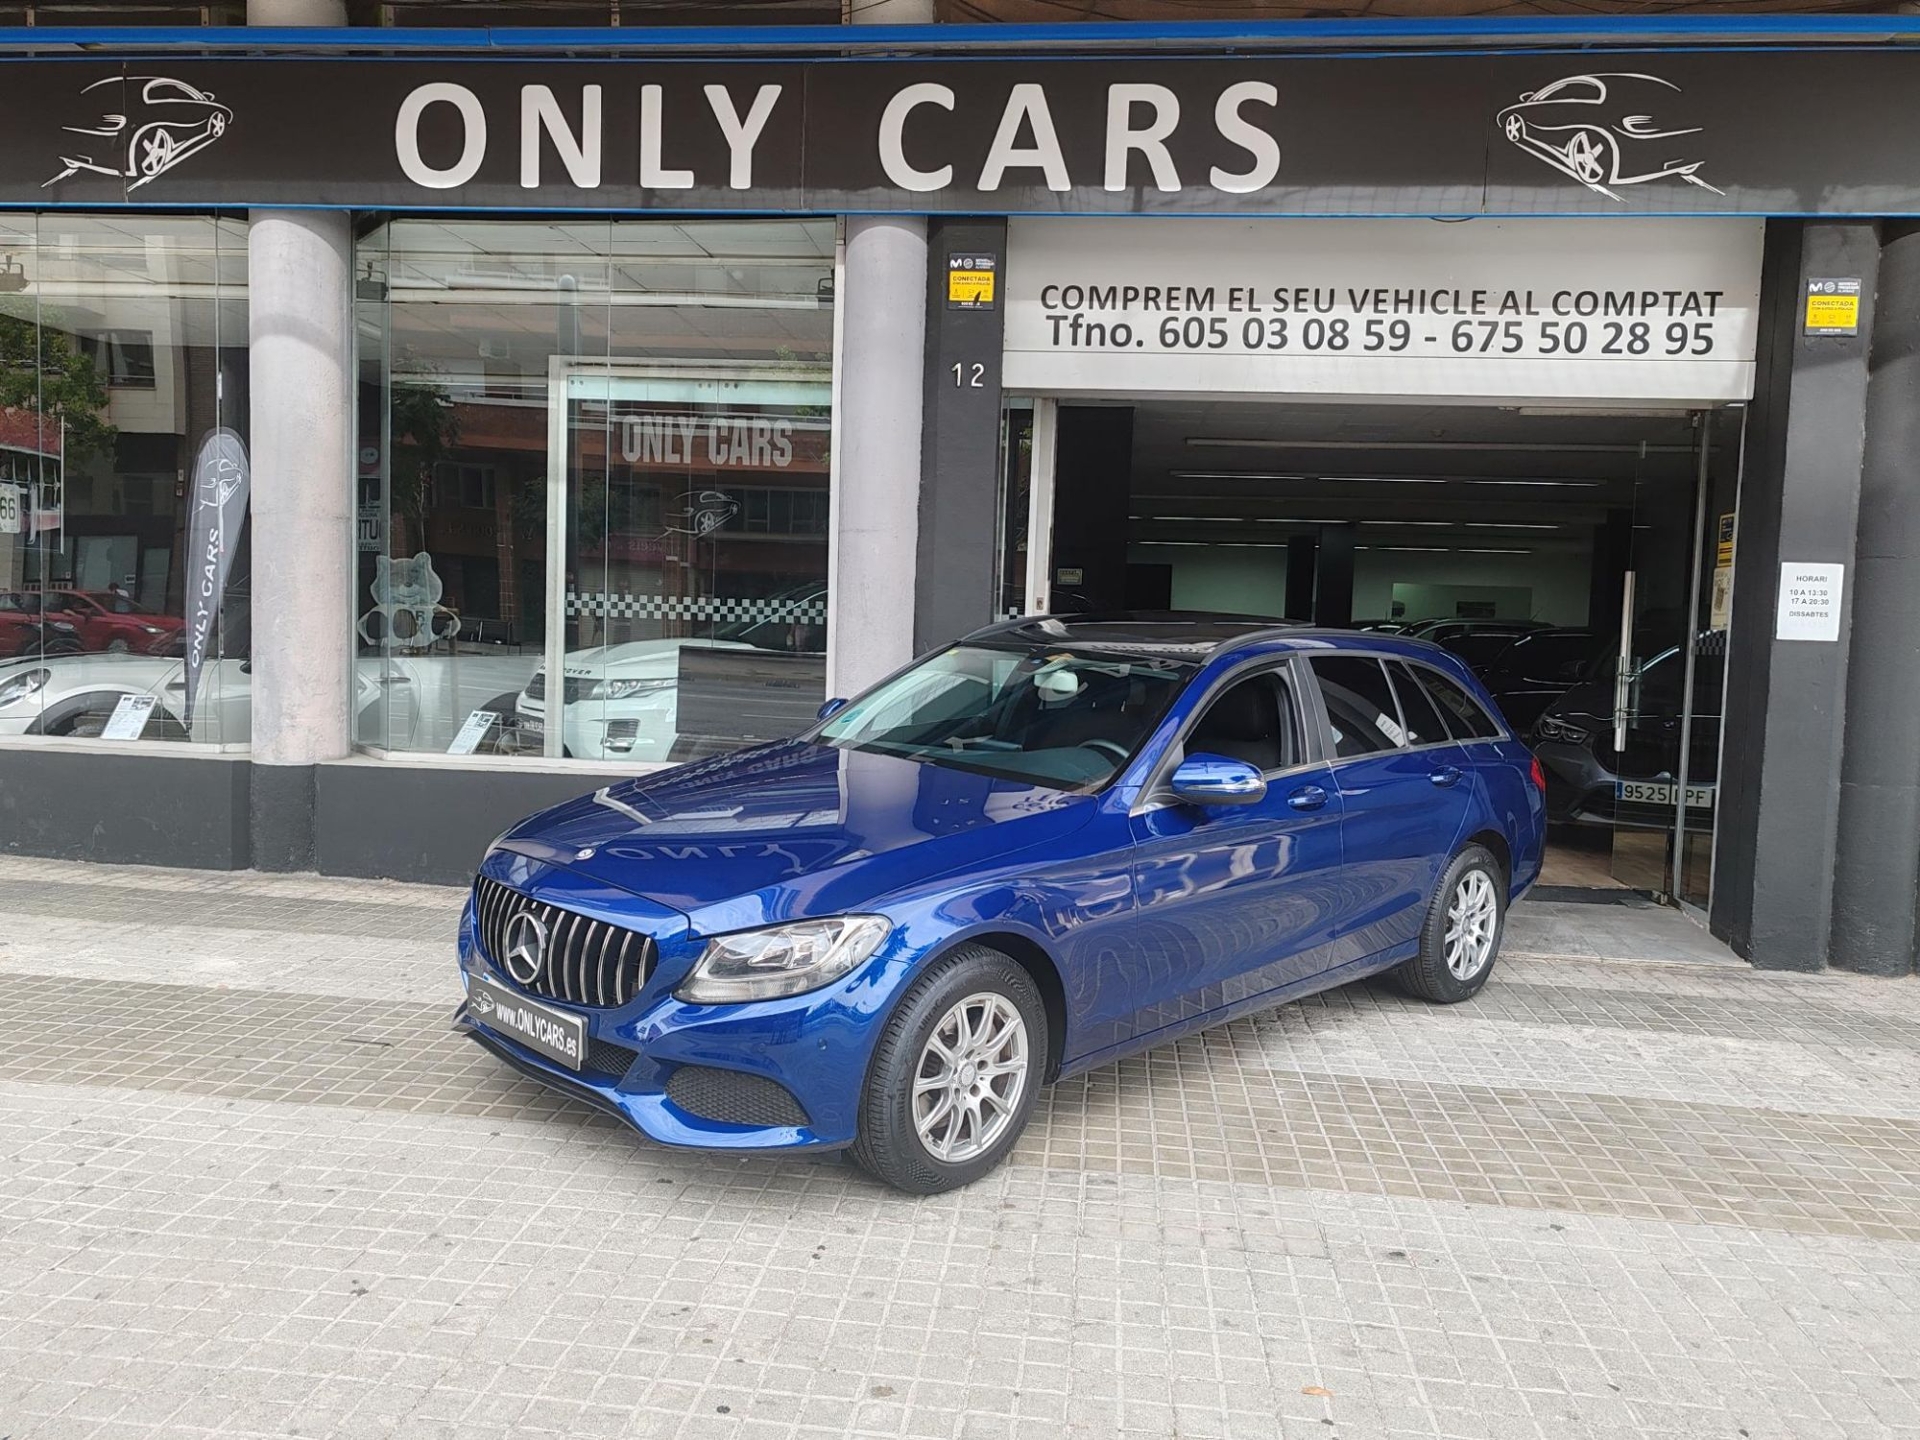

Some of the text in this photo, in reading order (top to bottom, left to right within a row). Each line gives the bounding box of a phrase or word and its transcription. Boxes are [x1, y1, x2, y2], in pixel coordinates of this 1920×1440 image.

[395, 81, 1281, 193] ONLY CARS
[1040, 284, 1723, 317] COMPREM EL SEU VEHICLE AL COMPTAT
[1045, 313, 1144, 347] Tfno.
[1159, 316, 1228, 348] 605
[1242, 317, 1288, 349] 03
[1302, 318, 1349, 350] 08
[1363, 319, 1411, 351] 59
[1452, 320, 1523, 353] 675
[1538, 321, 1587, 354] 50
[1601, 321, 1650, 355] 28
[1665, 322, 1714, 355] 95
[951, 362, 985, 387] 12
[622, 414, 793, 467] ONLY CARS
[191, 528, 219, 668] ONLY CARS
[1791, 597, 1800, 605] 17
[1624, 784, 1667, 802] 9525
[496, 1002, 577, 1058] www.ONLYCARS.es
